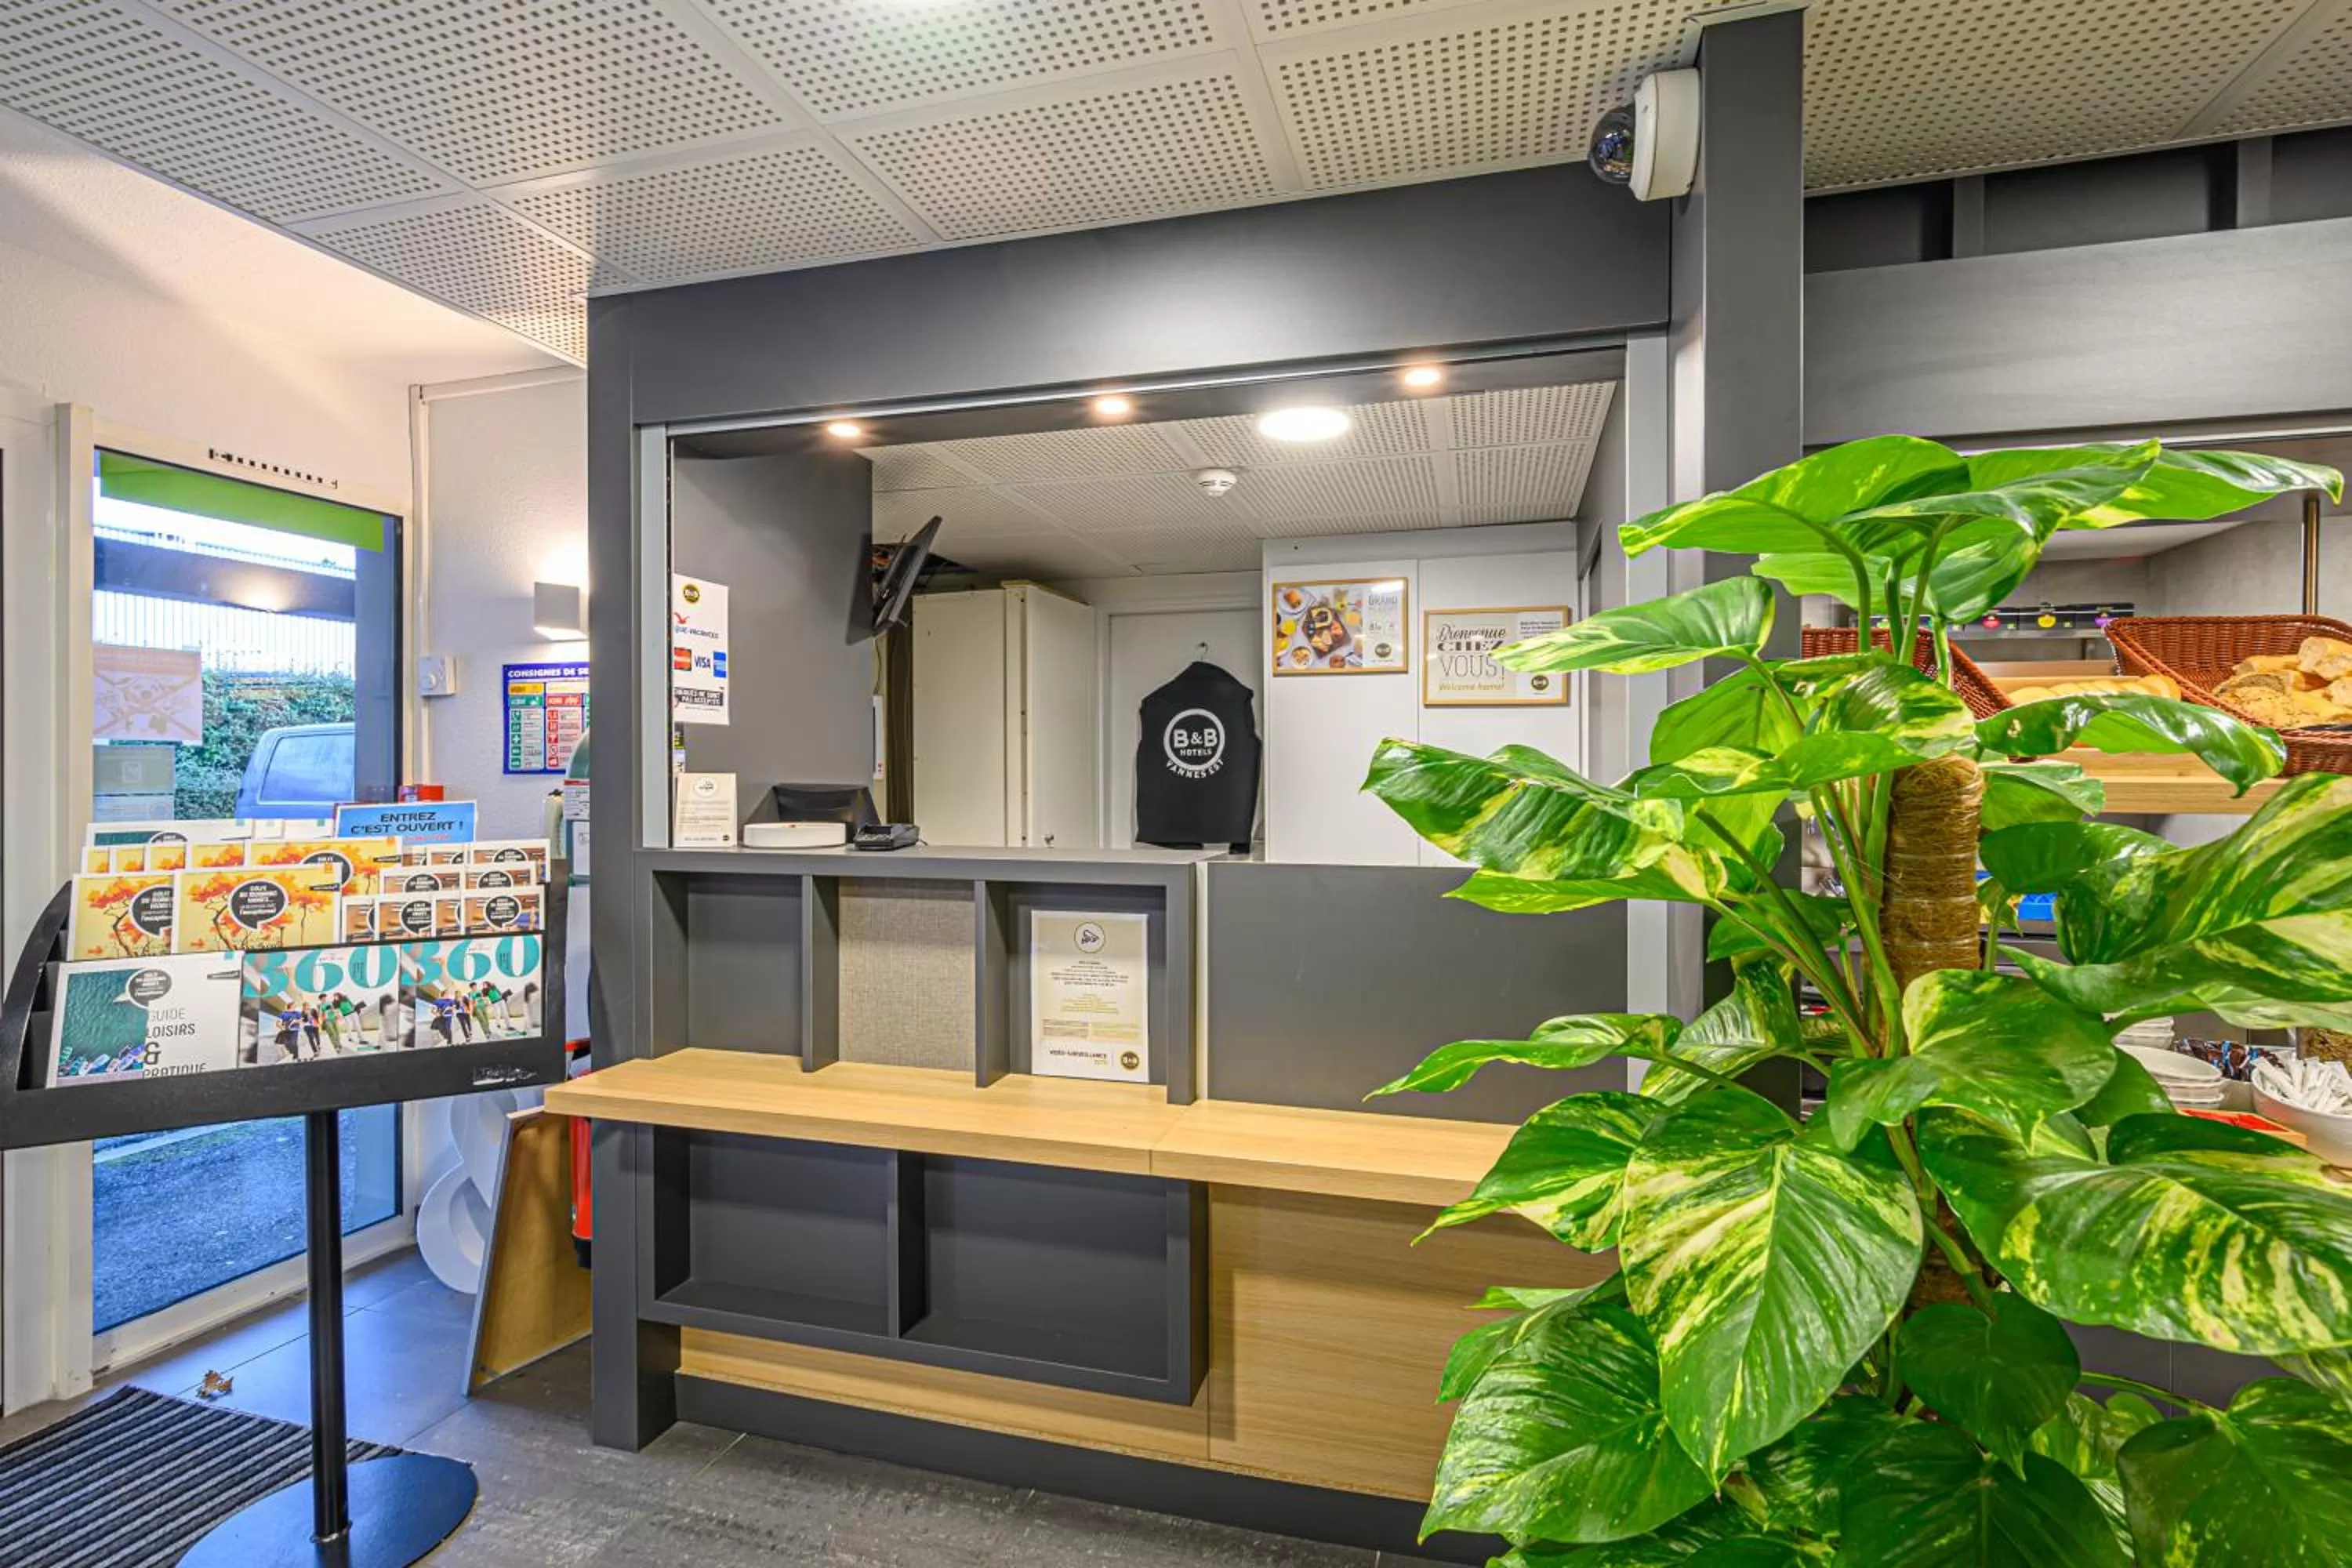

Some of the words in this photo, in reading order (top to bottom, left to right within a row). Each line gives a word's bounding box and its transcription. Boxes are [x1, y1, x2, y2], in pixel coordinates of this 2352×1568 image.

[695, 656, 711, 669] VISA
[508, 669, 561, 678] CONSIGNES
[1174, 728, 1218, 748] B&B
[1167, 760, 1207, 779] VANNES
[1208, 758, 1224, 775] EST
[380, 811, 436, 822] ENTREZ
[350, 823, 393, 834] C'EST
[396, 821, 454, 833] OUVERT
[401, 935, 539, 986] 360
[243, 947, 397, 998] 360
[147, 1023, 195, 1039] LOISIRS
